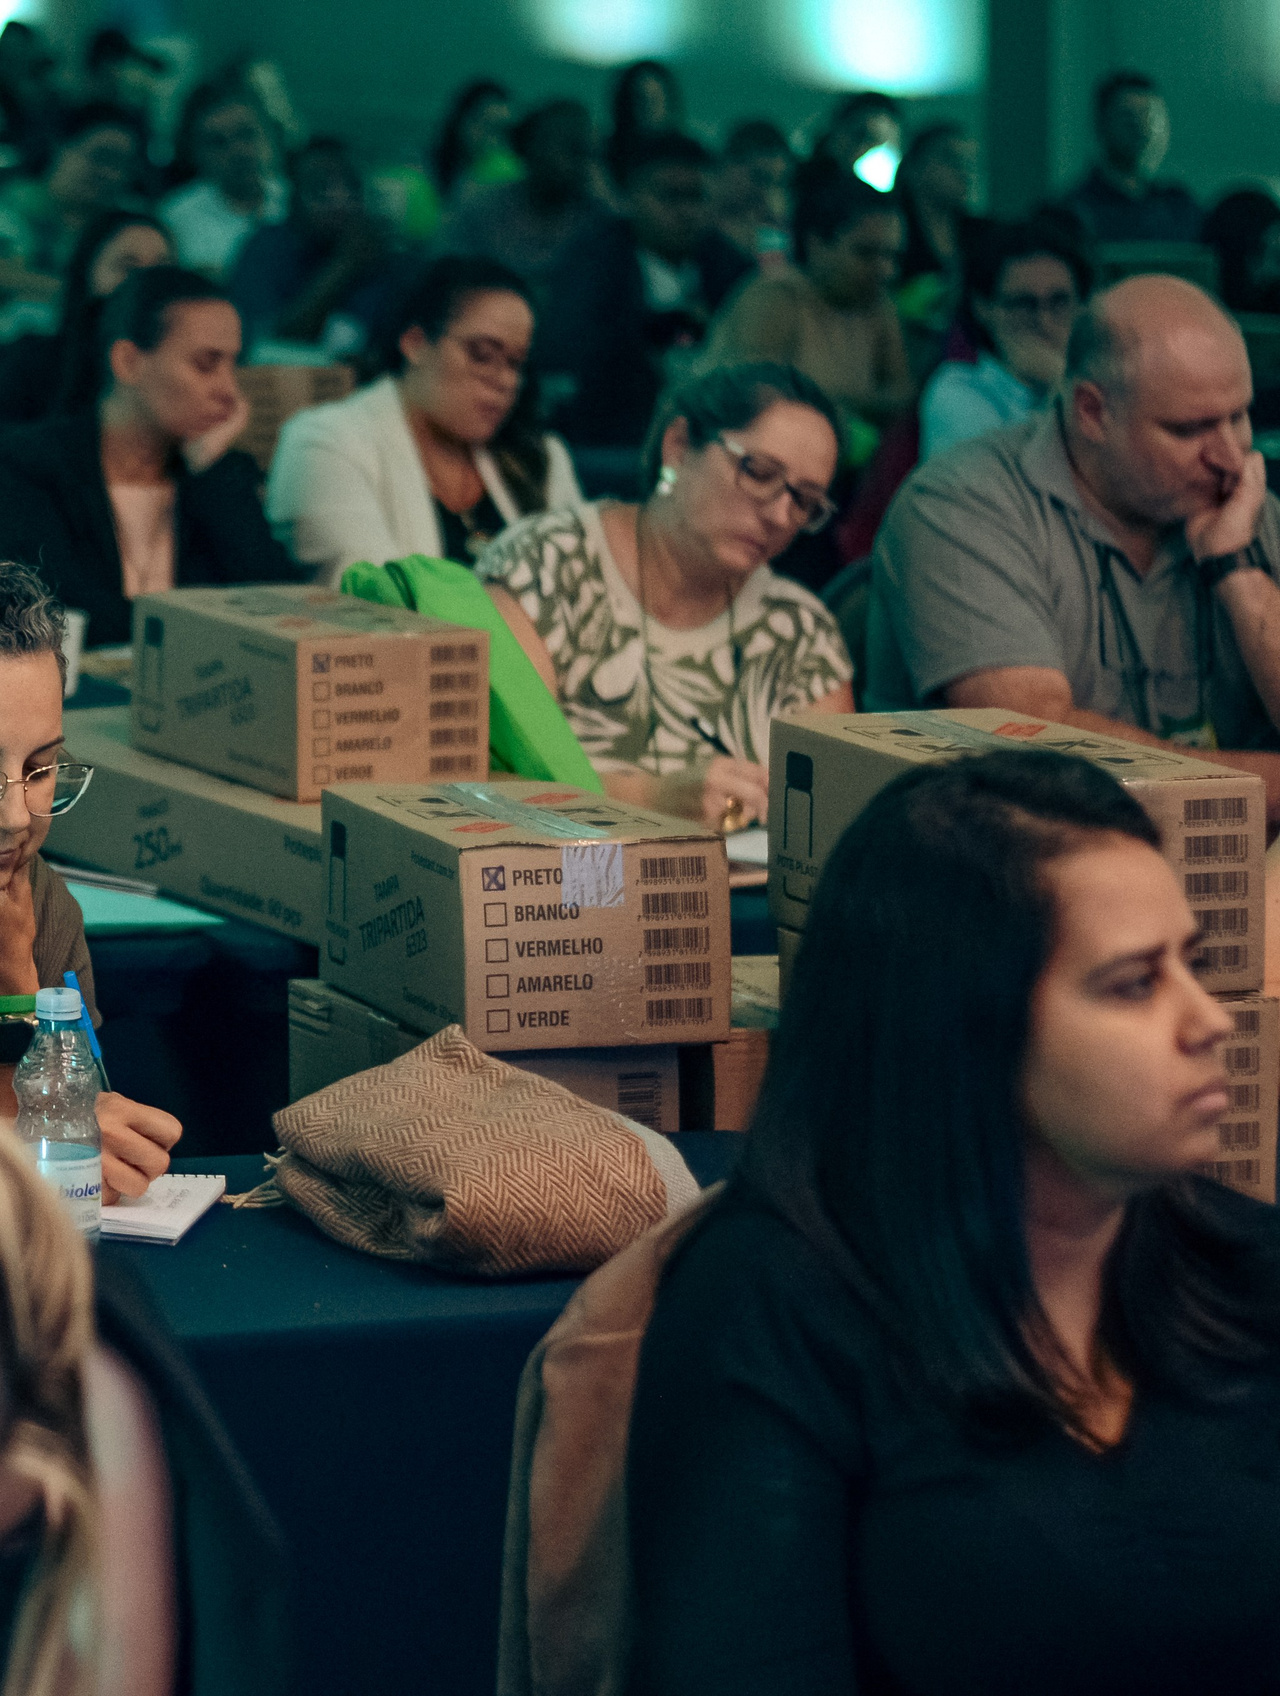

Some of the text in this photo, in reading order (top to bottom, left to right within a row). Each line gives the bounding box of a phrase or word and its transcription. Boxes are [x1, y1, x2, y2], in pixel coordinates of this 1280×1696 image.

[334, 653, 374, 668] PRETO
[334, 681, 384, 697] BRANCO
[334, 708, 401, 725] VERMELHO
[335, 736, 392, 752] AMARELO
[335, 764, 374, 780] VERDE
[512, 867, 563, 887] PRETO
[514, 901, 580, 922] BRANCO
[358, 896, 425, 952] TRIPARTIDA
[515, 936, 604, 958] VERMELHO
[515, 973, 594, 994] AMARELO
[516, 1009, 570, 1029] VERDE
